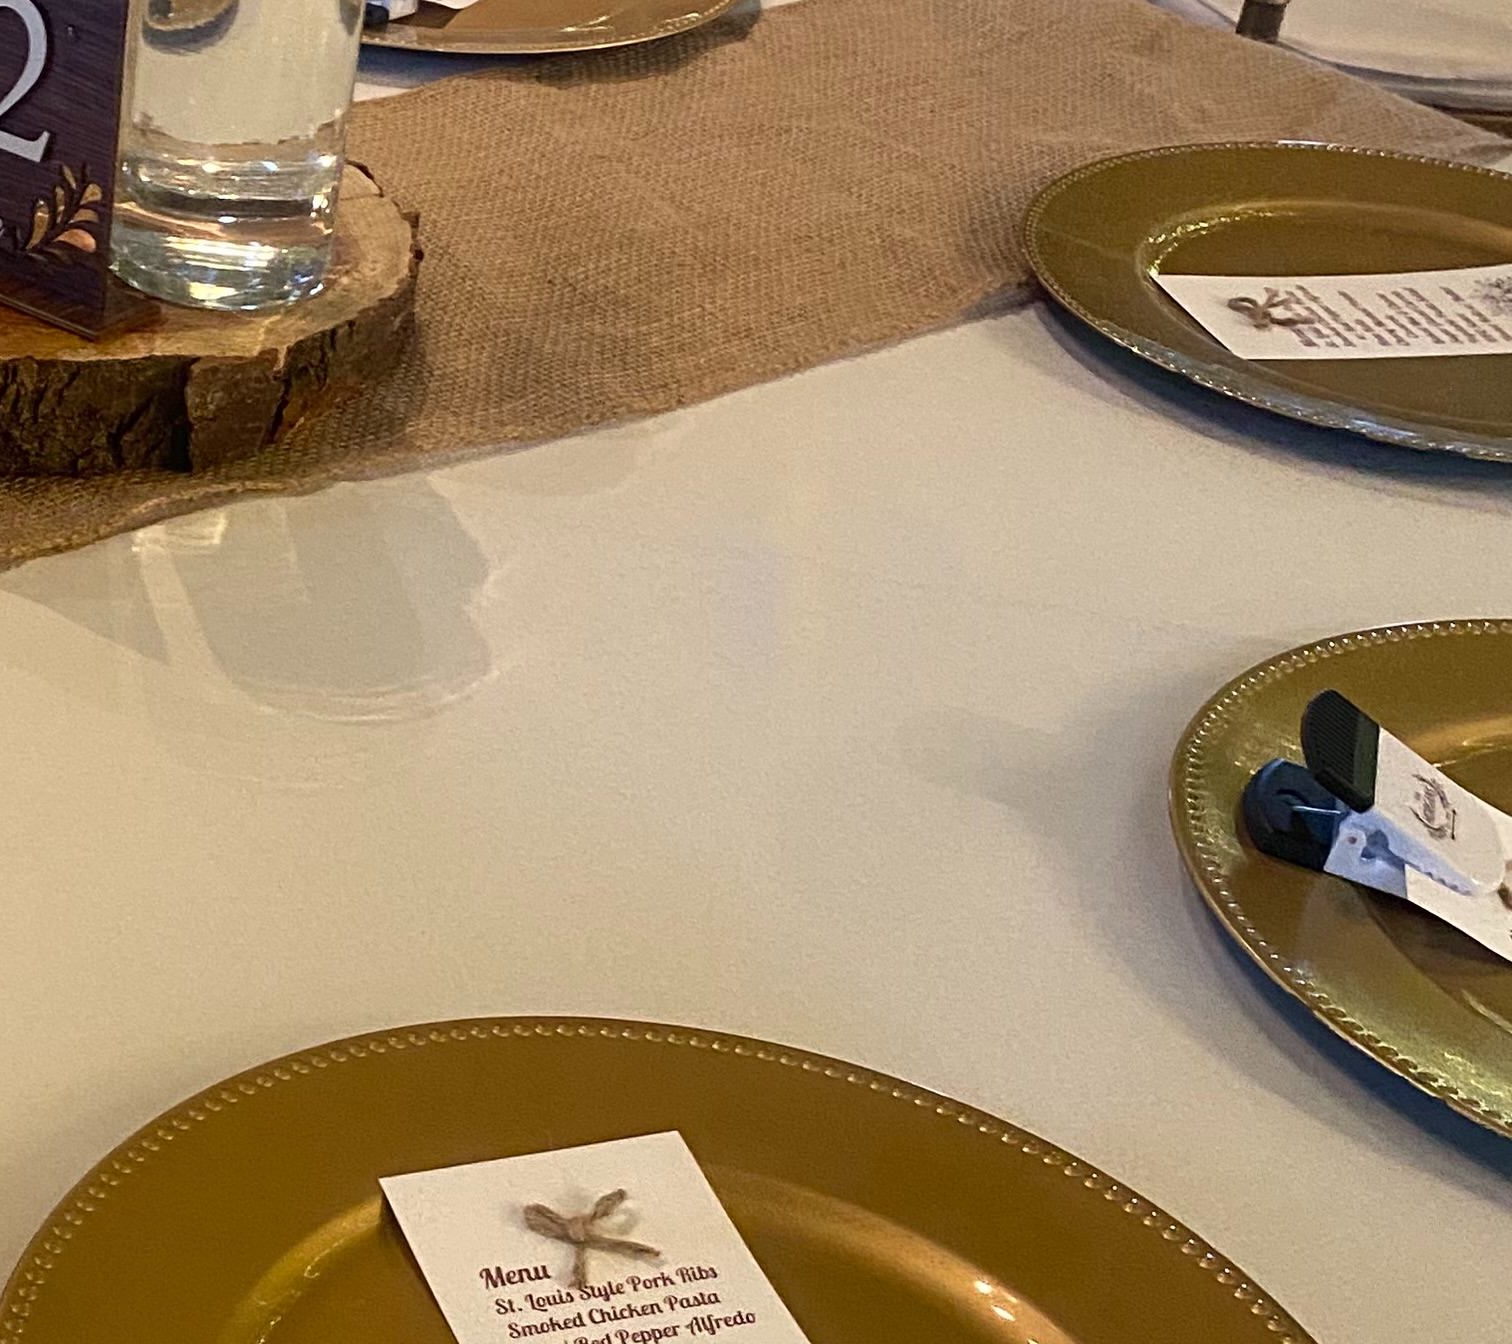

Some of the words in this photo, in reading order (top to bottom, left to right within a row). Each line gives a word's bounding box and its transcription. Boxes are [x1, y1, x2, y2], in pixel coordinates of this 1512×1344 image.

[479, 1264, 552, 1290] Menu
[494, 1297, 523, 1315] St.
[524, 1289, 574, 1312] Louis
[579, 1281, 625, 1303] Style
[625, 1273, 675, 1292] Pork
[676, 1265, 718, 1283] Ribs
[507, 1315, 587, 1339] Smoked
[588, 1302, 663, 1325] Chicken
[663, 1291, 721, 1312] Pasta
[684, 1311, 757, 1336] Alfredo
